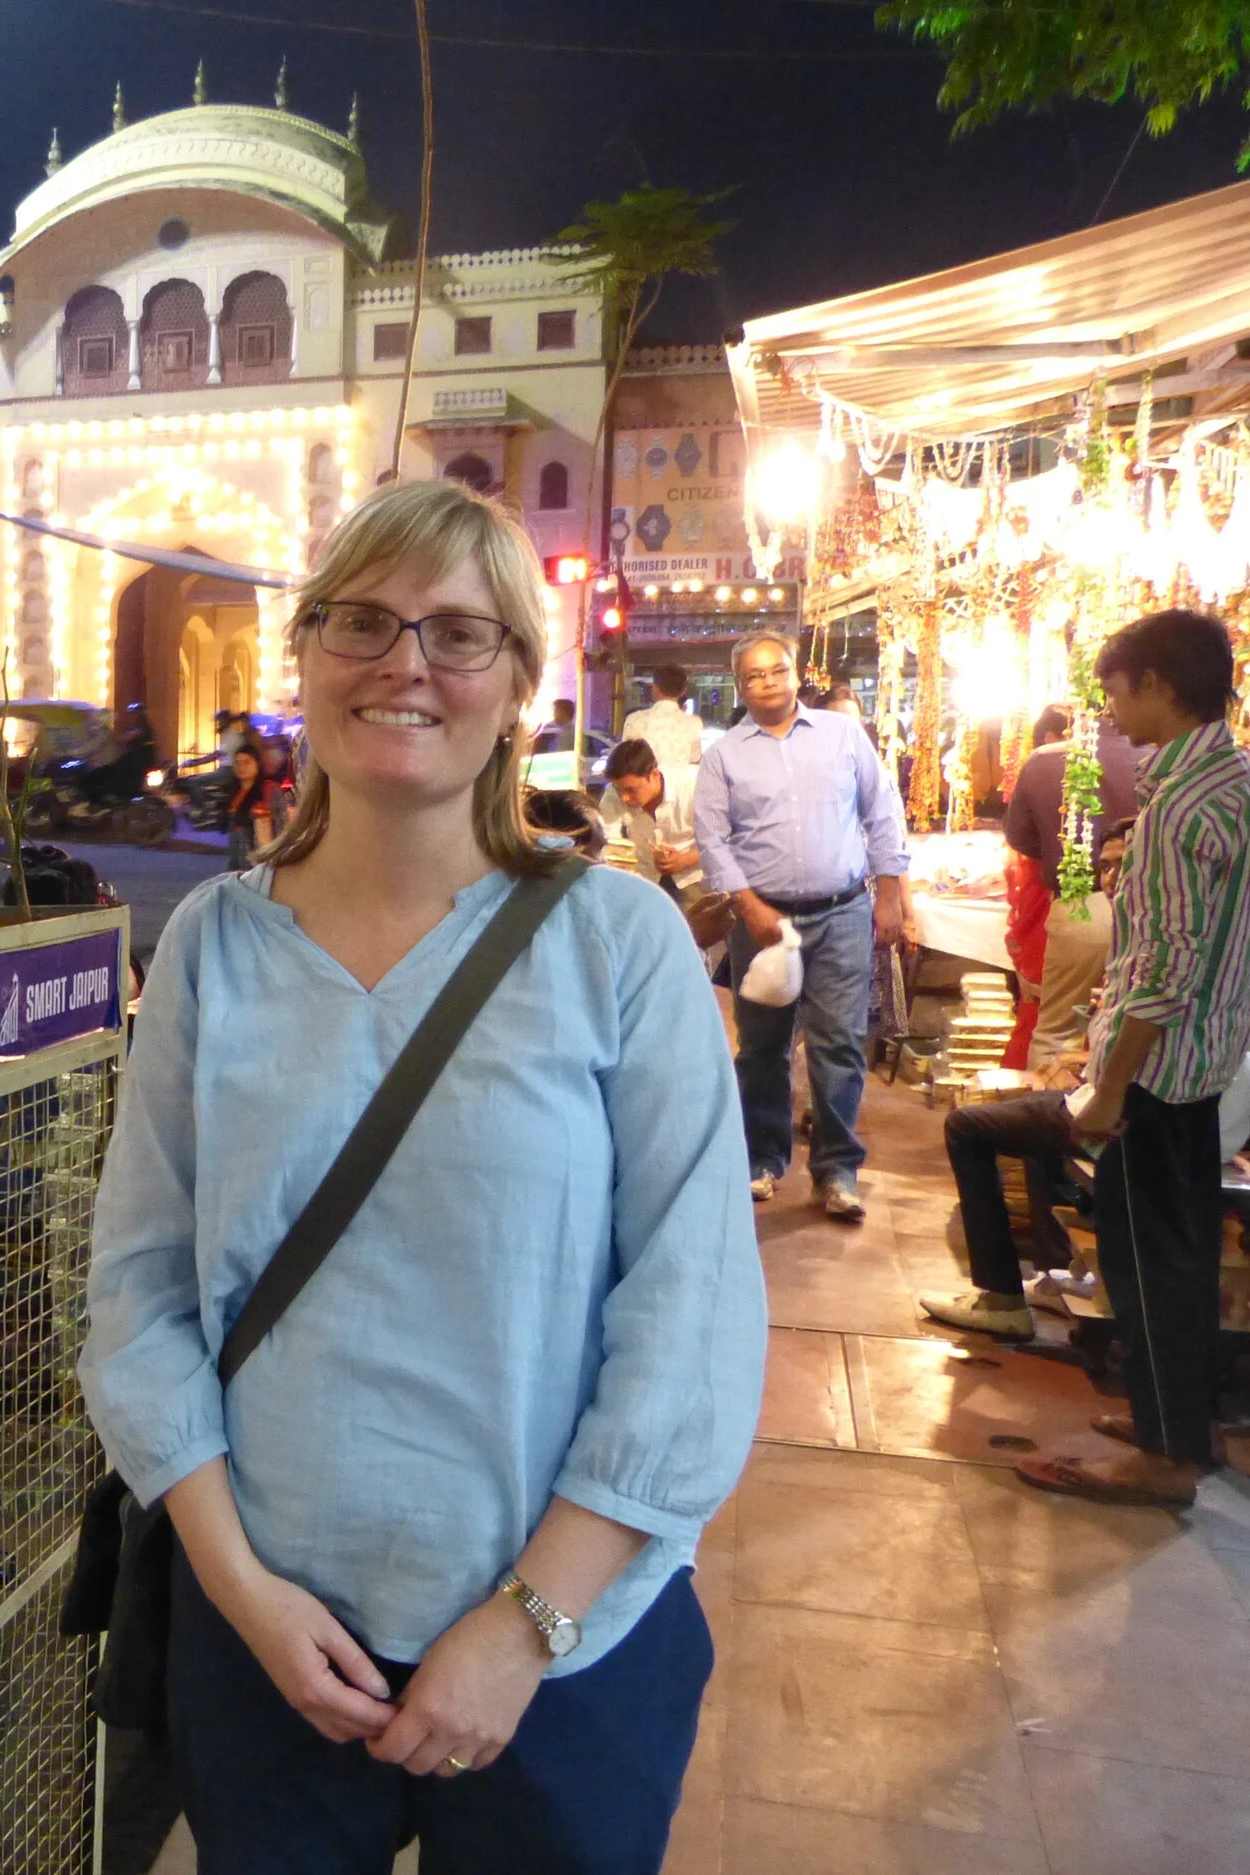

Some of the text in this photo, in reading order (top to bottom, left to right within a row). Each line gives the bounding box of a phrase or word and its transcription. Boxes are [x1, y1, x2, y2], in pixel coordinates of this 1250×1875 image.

[667, 485, 739, 502] CITIZEN
[671, 558, 708, 571] DEALER
[26, 966, 109, 1024] SMART JAIPUR
